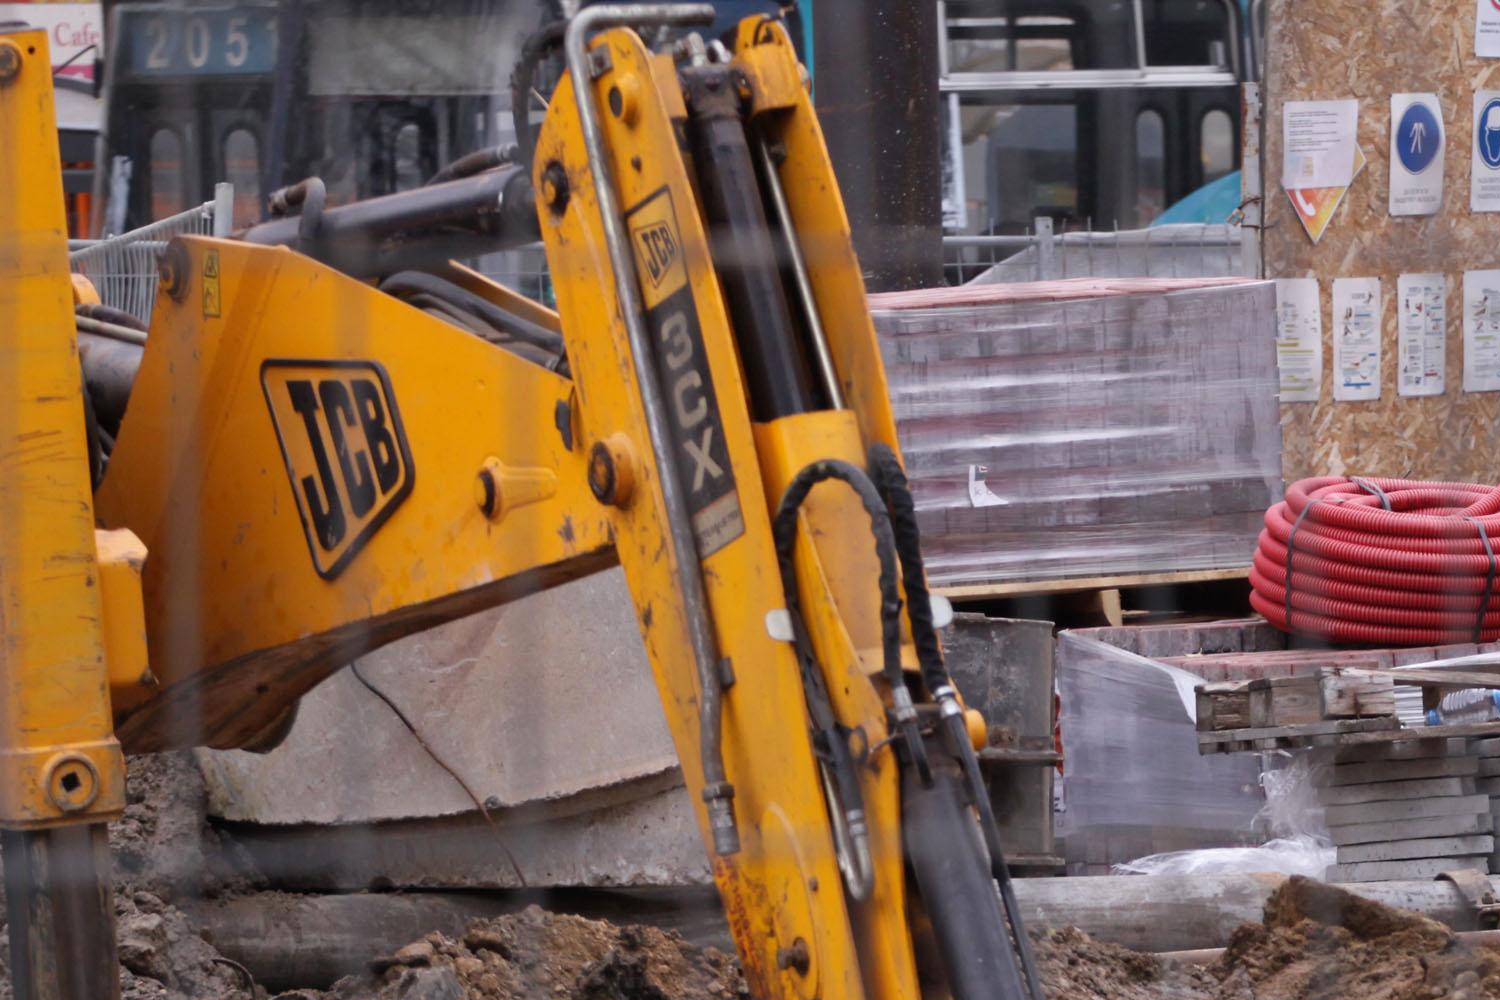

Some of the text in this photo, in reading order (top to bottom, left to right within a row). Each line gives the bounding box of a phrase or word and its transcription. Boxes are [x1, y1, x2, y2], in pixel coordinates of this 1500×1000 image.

[641, 226, 676, 279] JCB
[286, 379, 399, 552] JCB
[661, 311, 724, 494] 3CX
